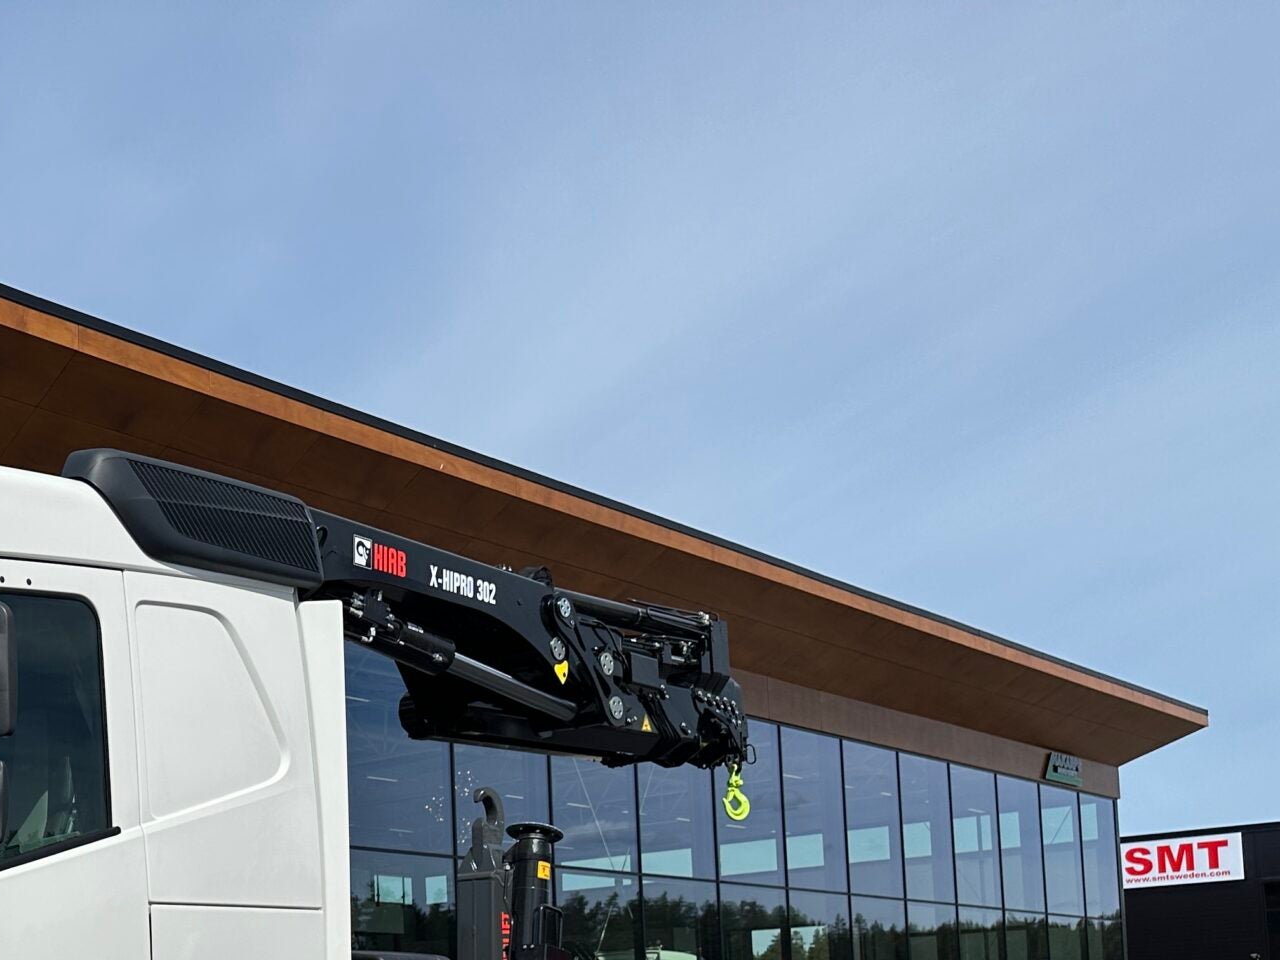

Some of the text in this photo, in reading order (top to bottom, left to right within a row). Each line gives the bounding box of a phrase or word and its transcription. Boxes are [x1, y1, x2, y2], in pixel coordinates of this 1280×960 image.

[373, 543, 406, 578] HIAB
[429, 564, 496, 605] X-HIPRO 302
[1124, 839, 1228, 877] SMT
